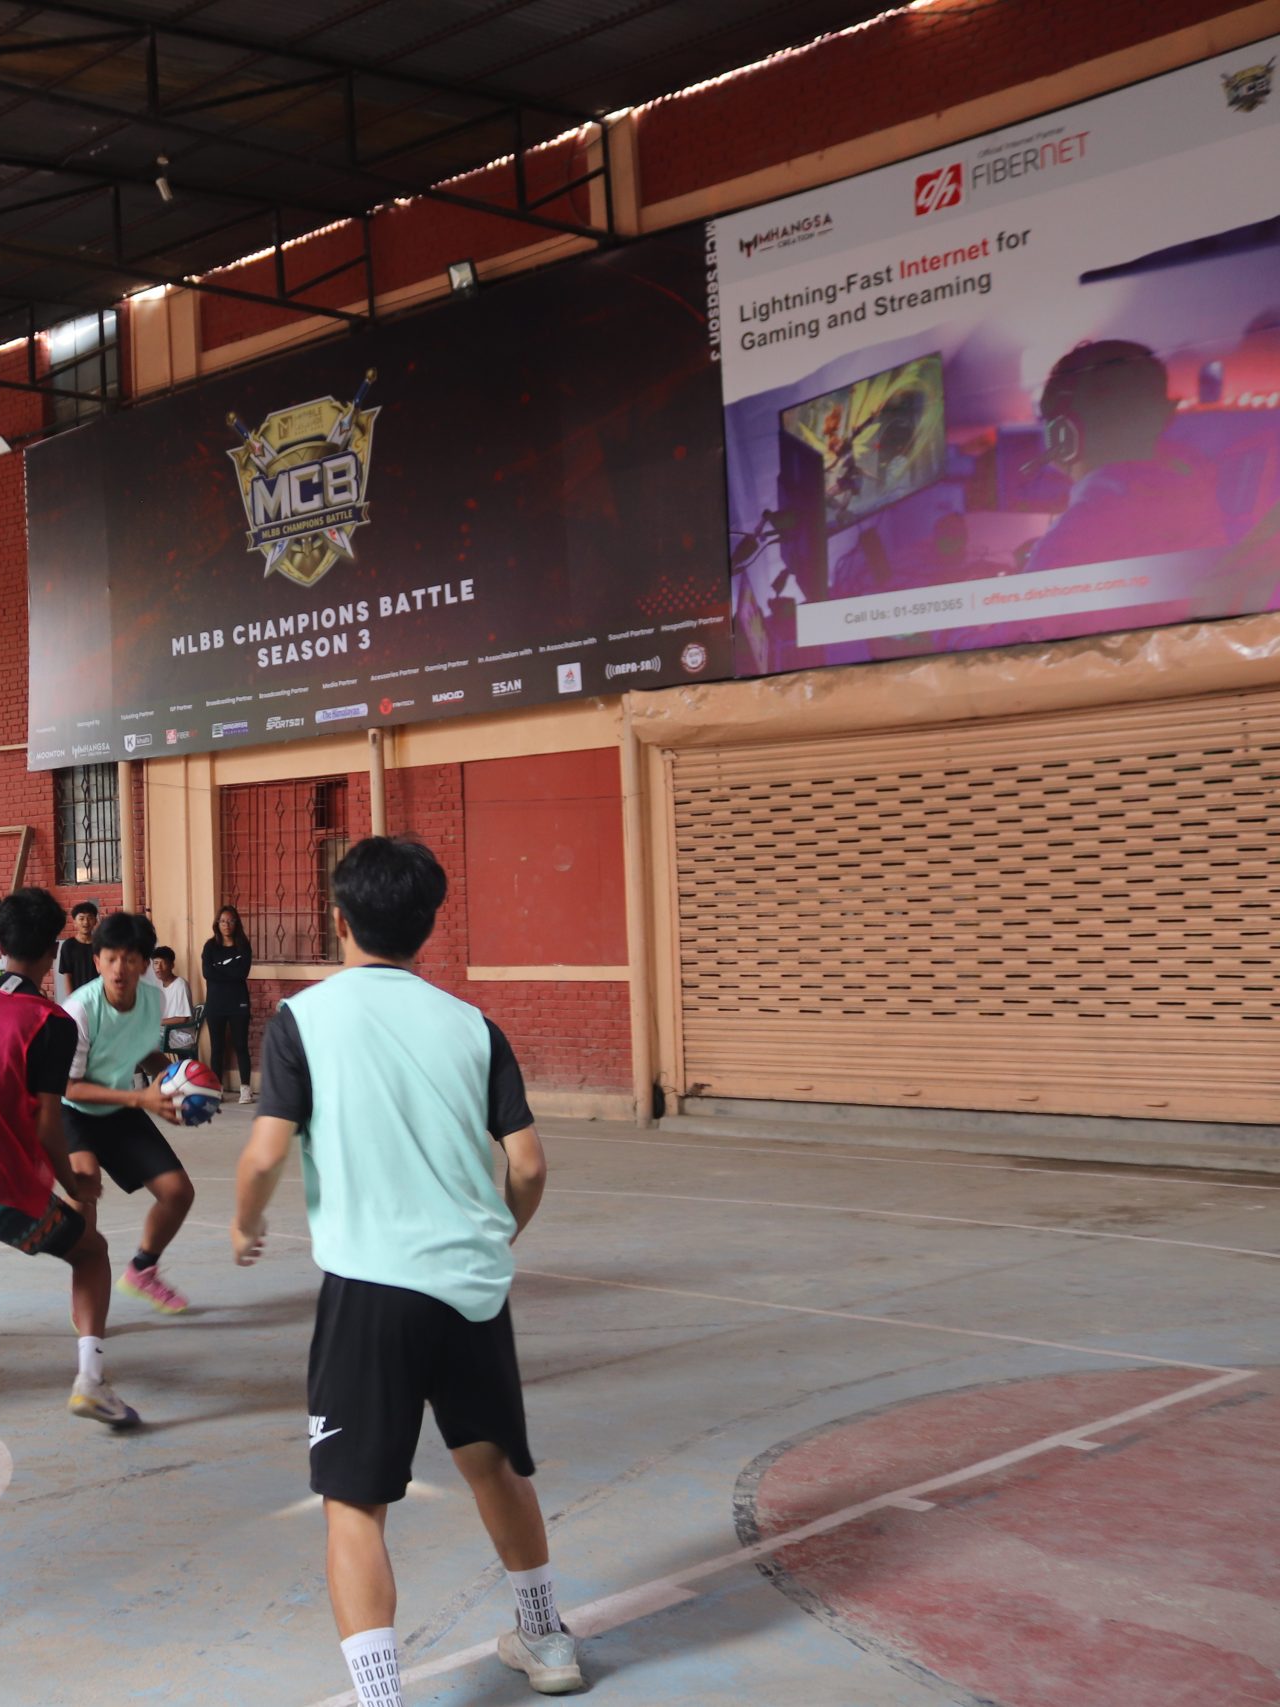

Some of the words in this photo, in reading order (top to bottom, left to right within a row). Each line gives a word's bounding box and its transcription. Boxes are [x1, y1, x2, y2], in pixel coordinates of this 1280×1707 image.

[971, 131, 1091, 190] FIBERNET
[759, 213, 833, 246] MHANGSA
[739, 265, 894, 322] Lightning-Fast
[899, 238, 990, 280] Internet
[997, 229, 1032, 252] for
[740, 319, 821, 351] Gaming
[827, 302, 867, 329] and
[874, 272, 992, 316] Streaming
[252, 453, 359, 526] MCB
[261, 526, 281, 539] MLBB
[282, 517, 324, 534] CHAMPIONS
[326, 508, 353, 524] BATTLE
[171, 629, 225, 656] MLBB
[232, 600, 370, 645] CHAMPIONS
[379, 578, 475, 618] BATTLE
[698, 616, 724, 625] Partner
[844, 610, 867, 624] Call
[871, 609, 891, 621] Us:
[257, 632, 348, 668] SEASON
[358, 628, 371, 650] 3
[608, 632, 629, 641] Sound
[630, 627, 655, 637] Partner
[399, 667, 420, 677] Partner
[424, 663, 448, 672] Gaming
[448, 659, 469, 668] Partner
